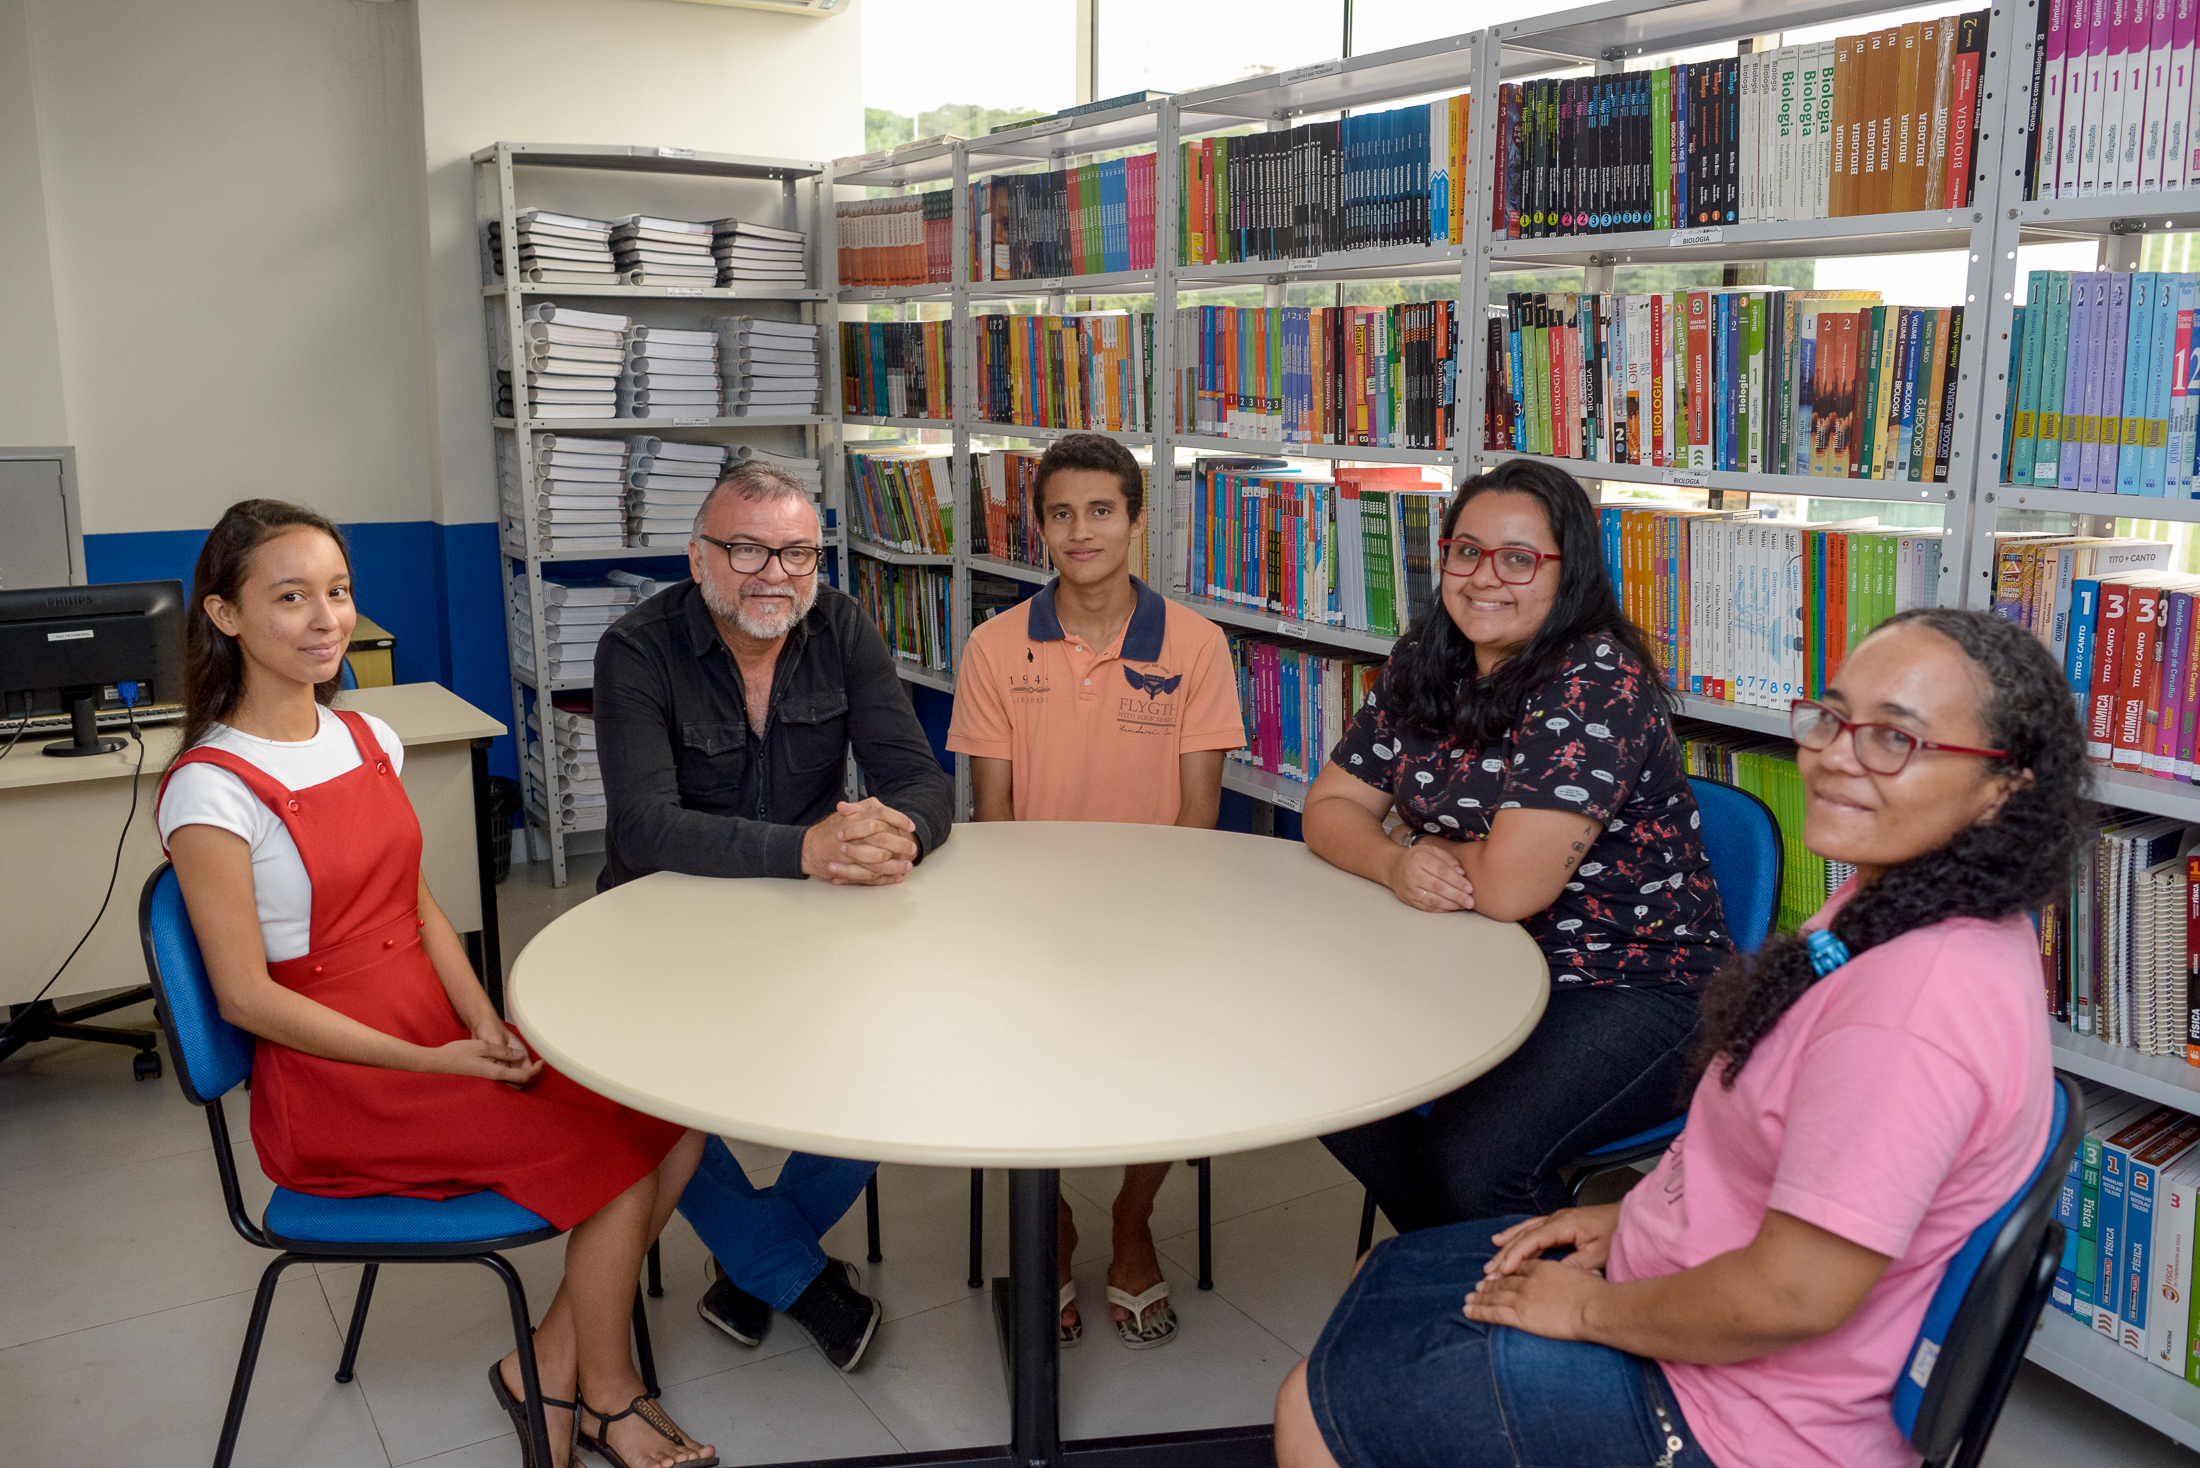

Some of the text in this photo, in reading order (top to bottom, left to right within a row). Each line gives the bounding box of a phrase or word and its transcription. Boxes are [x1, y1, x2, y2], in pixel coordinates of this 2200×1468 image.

[1963, 18, 1977, 28] 2
[2029, 98, 2037, 132] Conexões
[2035, 46, 2043, 75] Biologia
[2051, 75, 2056, 96] 1
[2073, 72, 2079, 93] 1
[2093, 71, 2099, 92] 1
[1072, 100, 1113, 116] ATLAS UNIVERSAL
[1778, 71, 1794, 137] Biologia
[1799, 70, 1816, 137] Biologia
[1817, 67, 1834, 134] Biologia
[1881, 117, 1891, 171] BIOLOGIA
[1900, 113, 1909, 163] BIOLOGIA
[1916, 112, 1928, 167] BIOLOGIA
[1938, 107, 1948, 157] BIOLOGIA
[1953, 106, 1967, 168] BIOLOGIA
[1835, 125, 1844, 172] BIOLOGIA
[1851, 122, 1860, 175] BIOLOGIA
[1866, 120, 1876, 173] BIOLOGIA
[1683, 236, 1709, 244] BIOLOGIA
[1693, 299, 1703, 315] 3
[1824, 320, 1831, 331] 2
[1356, 326, 1366, 354] dante
[1675, 316, 1686, 390] conecte Biologia
[1628, 363, 1638, 384] BIO
[2172, 348, 2186, 390] 1
[1654, 375, 1662, 437] BIOLOGIA
[1739, 373, 1747, 414] Biologia
[1945, 382, 1956, 421] MODERNA
[1615, 428, 1625, 441] 2
[1913, 407, 1926, 456] BIOLOGIA
[1925, 400, 1939, 458] BIOLOGIA 3
[2125, 447, 2134, 466] Coleção
[1674, 477, 1699, 485] BIOLOGIA
[2109, 554, 2156, 564] TITO CANTO
[46, 596, 92, 607] PHILIPS
[2080, 591, 2092, 615] 1
[2105, 594, 2125, 618] 3
[2136, 598, 2155, 623] 3
[2157, 599, 2169, 627] 3
[2077, 624, 2087, 654] CANTO
[2105, 627, 2115, 657] CANTO
[2172, 627, 2183, 655] Camargo
[2074, 662, 2083, 680] TITO
[2103, 665, 2112, 683] TITO
[2172, 656, 2179, 667] de
[1735, 675, 1744, 687] 6
[1759, 679, 1767, 691] 7
[1770, 682, 1778, 693] 8
[1783, 683, 1792, 694] 9
[2168, 668, 2178, 698] Carvalho
[2093, 694, 2109, 738] QUÍMICA
[2123, 699, 2140, 743] QUÍMICA
[2181, 749, 2190, 759] 2
[2189, 1007, 2200, 1039] FÍSICA
[2102, 1175, 2124, 1187] RAMALHO
[2103, 1182, 2123, 1193] NICOLAU
[2134, 1171, 2149, 1190] 2
[2062, 1186, 2074, 1217] Física
[2082, 1197, 2095, 1228] Física
[2105, 1227, 2115, 1257] FÍSICA
[2132, 1242, 2143, 1273] FÍSICA
[2166, 1264, 2174, 1285] FÍSICA
